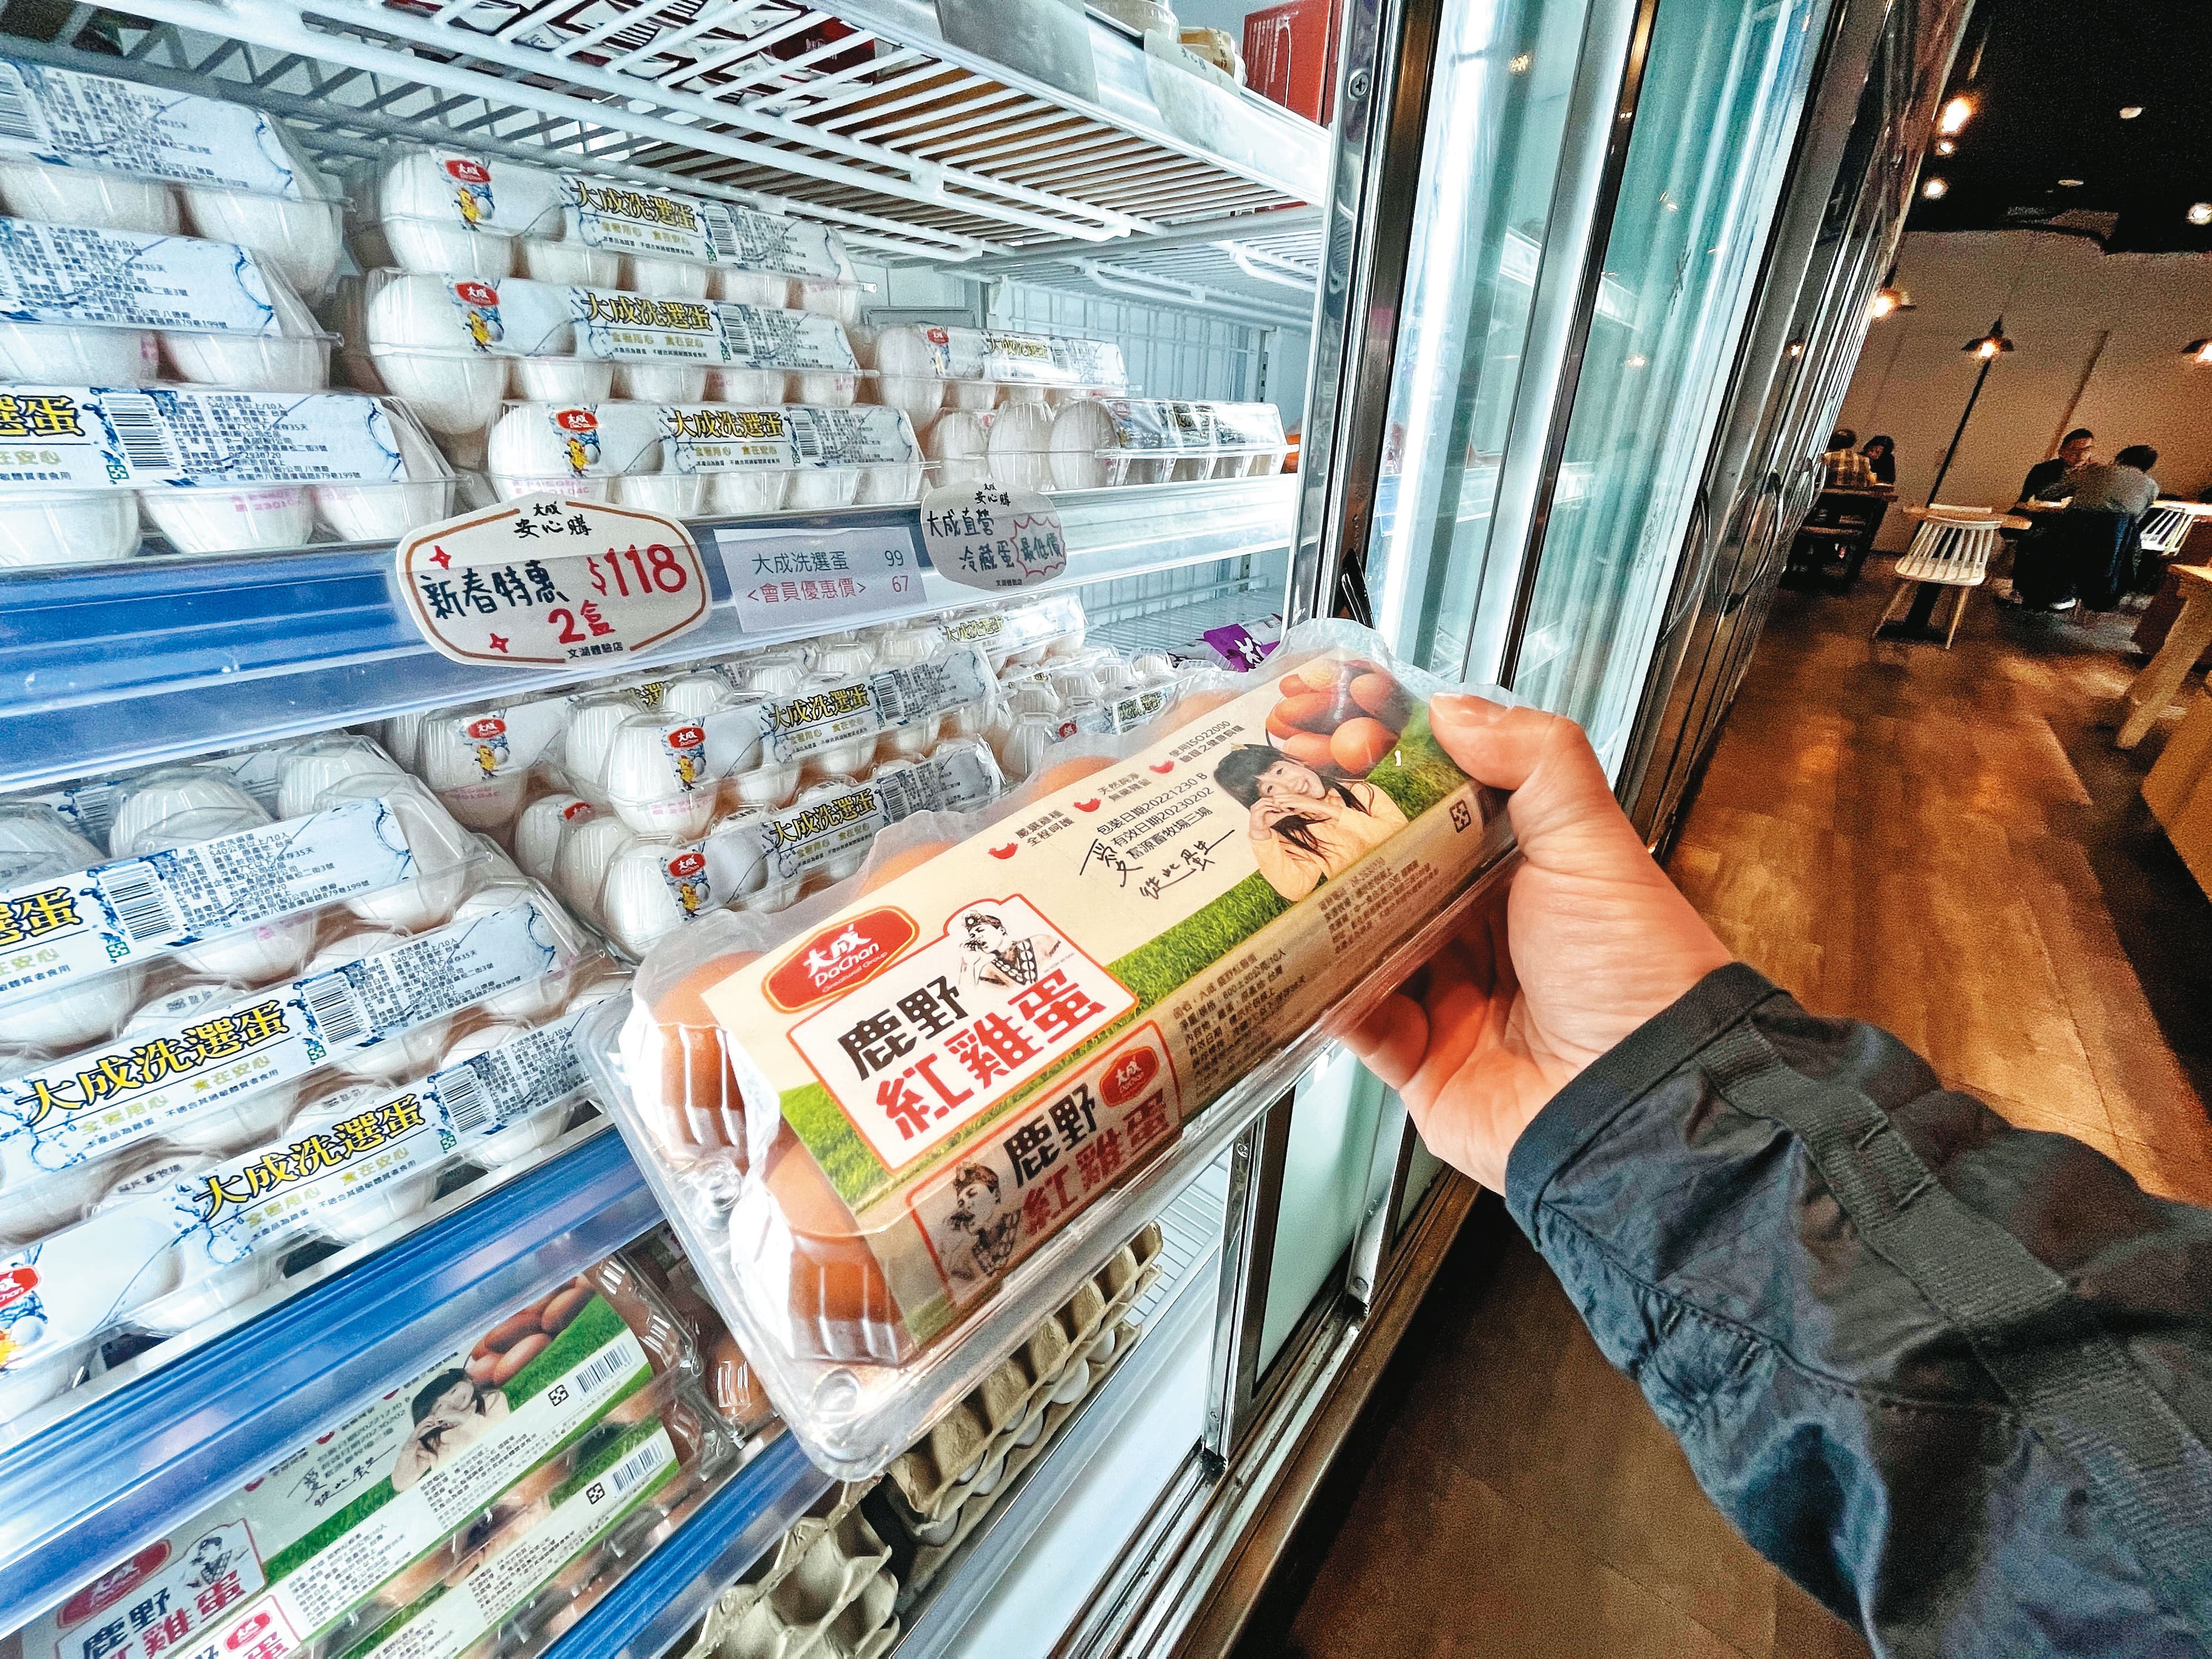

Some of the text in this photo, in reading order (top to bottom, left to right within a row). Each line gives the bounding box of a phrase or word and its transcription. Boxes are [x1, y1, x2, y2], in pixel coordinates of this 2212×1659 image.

[572, 181, 698, 232] 大成洗選蛋
[581, 293, 713, 331] 大成洗選蛋
[668, 410, 785, 438] 大成洗選蛋
[975, 490, 1011, 506] 安心購
[514, 514, 592, 538] 安心購
[927, 507, 994, 537] 大成直營
[752, 550, 904, 575] 大成洗選蛋 99
[959, 540, 1014, 572] 冷藏蛋
[1021, 532, 1062, 562] 最低價
[420, 544, 687, 620] 新春特惠 $118
[892, 575, 909, 593] 67
[548, 600, 616, 645] 2盒
[567, 642, 623, 660] 文湖體驗店
[768, 683, 870, 732] 大成洗選蛋
[677, 729, 698, 742] 大成
[1168, 720, 1231, 758] 使用ISO22000
[769, 788, 877, 848] 大成洗選蛋
[1096, 772, 1208, 836] 包裝日期20221230 B
[1111, 786, 1215, 848] 有效日期20230202
[1026, 817, 1075, 847] 全程呵護
[1125, 806, 1213, 860] 富源畜牧場三場
[678, 855, 698, 869] 大成
[802, 925, 872, 976] 大成
[813, 941, 881, 988] DaChan
[837, 975, 970, 1081] 鹿野
[15, 1000, 291, 1127] 大成洗選蛋
[875, 968, 1107, 1142] 紅雞蛋
[192, 1093, 426, 1222] 大成洗選蛋
[1002, 1082, 1097, 1188] 鹿野
[1022, 1088, 1171, 1237] 紅雞蛋
